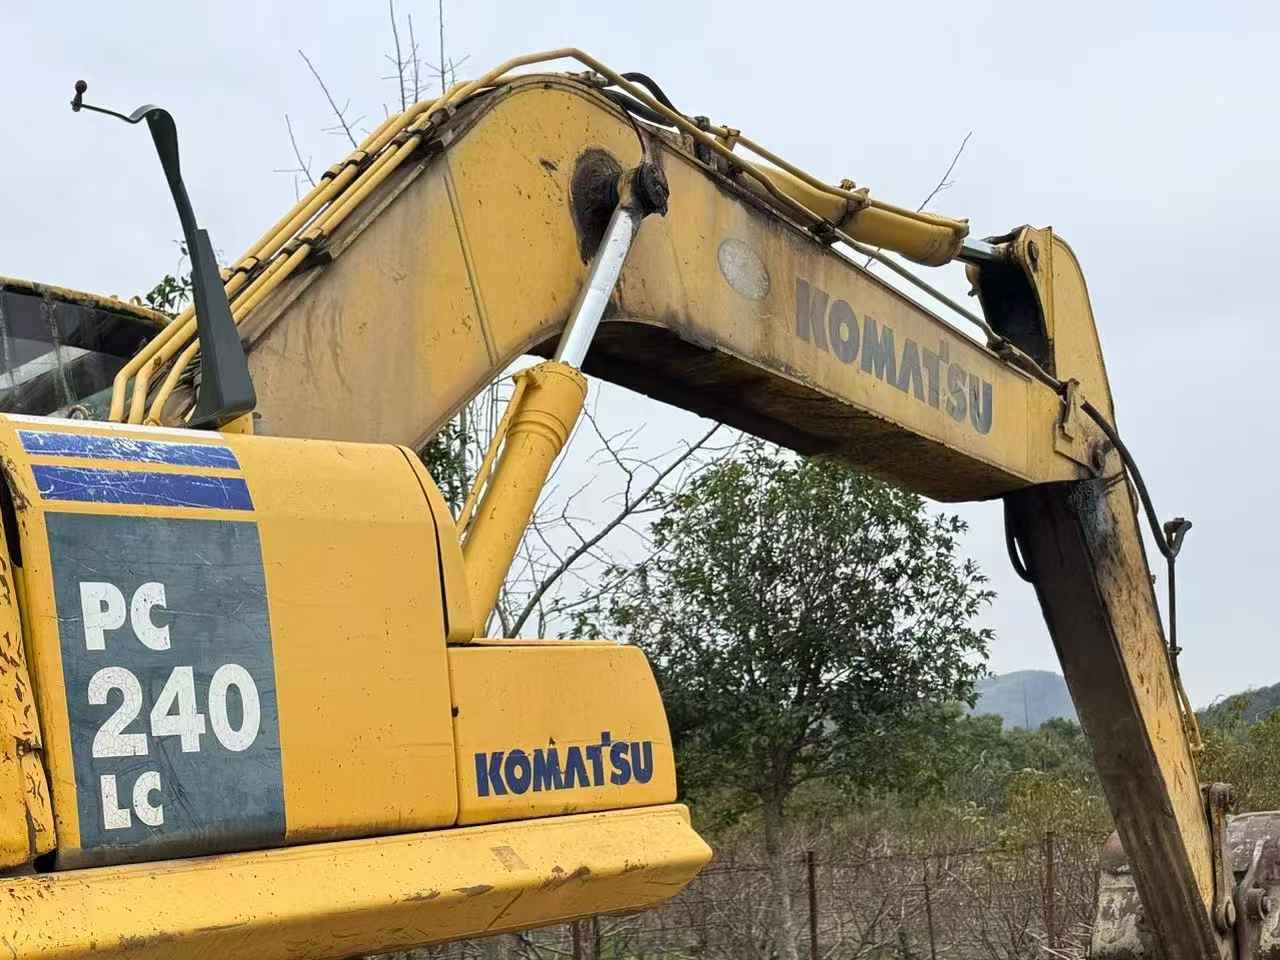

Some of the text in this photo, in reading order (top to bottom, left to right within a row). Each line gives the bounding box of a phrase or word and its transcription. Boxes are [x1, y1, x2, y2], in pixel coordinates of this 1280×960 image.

[796, 280, 993, 434] KOMATSU
[80, 582, 171, 650] PC
[88, 664, 261, 757] 240
[475, 731, 653, 796] KOMATSU
[101, 771, 164, 829] LC
